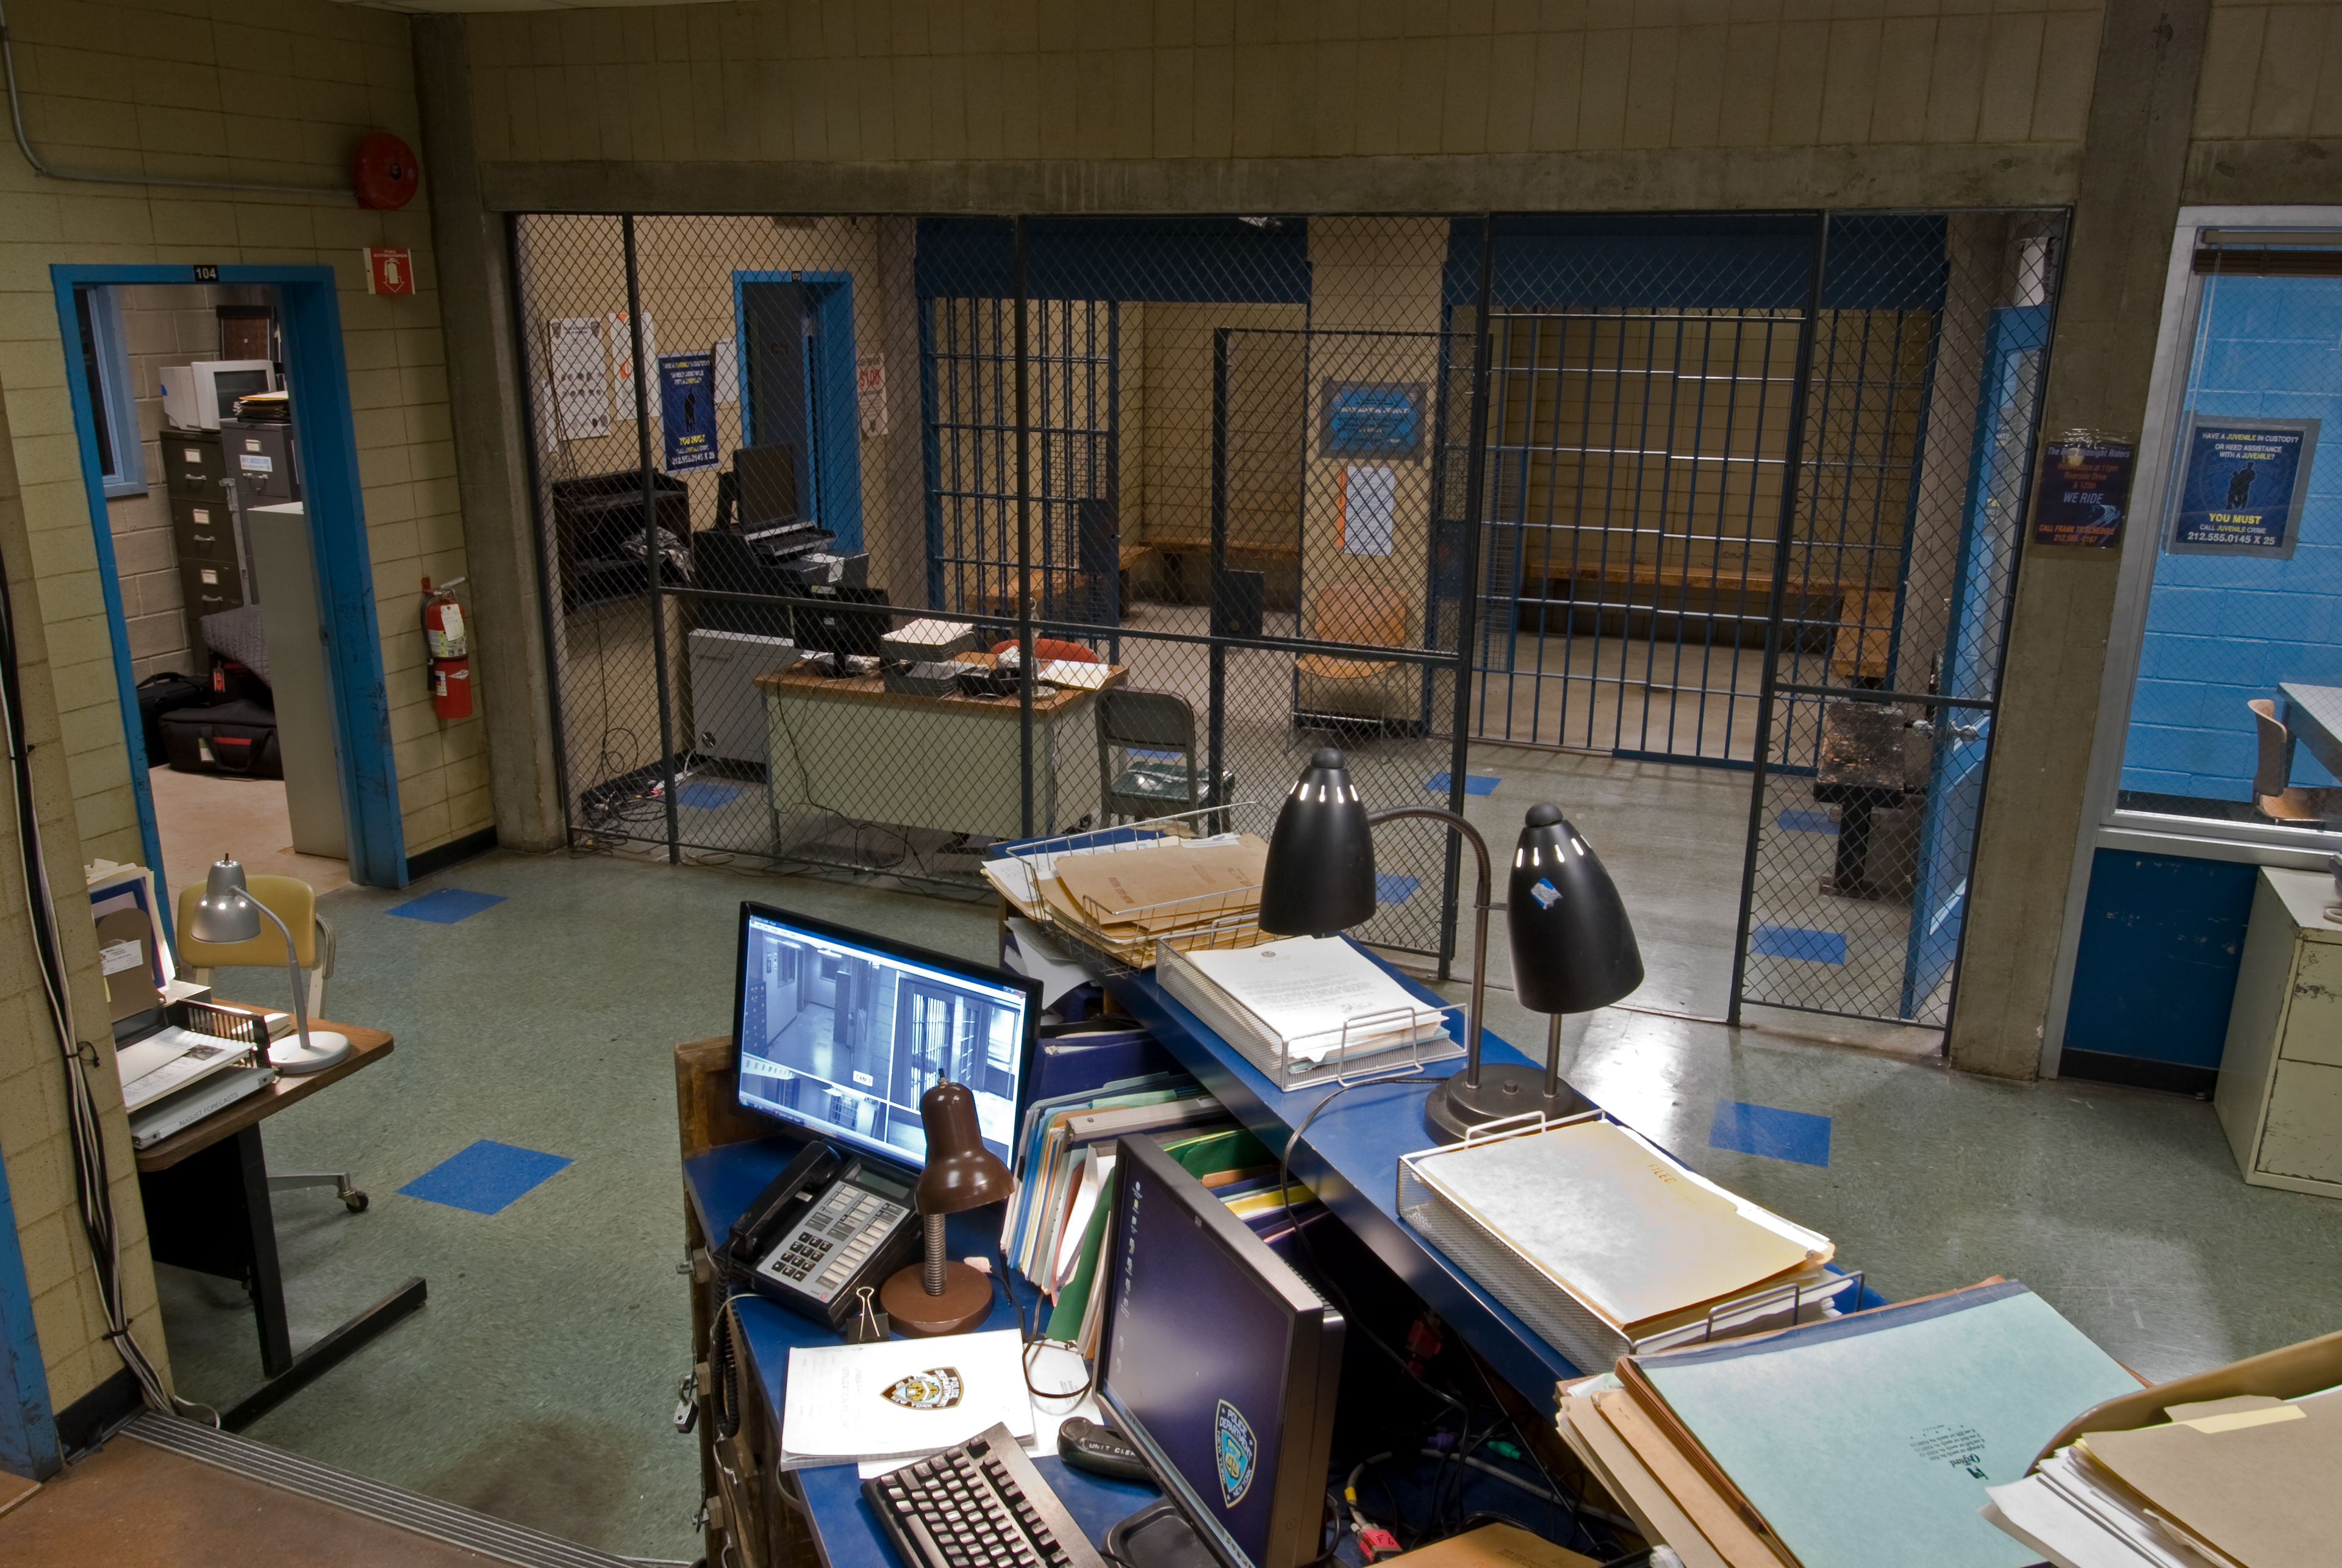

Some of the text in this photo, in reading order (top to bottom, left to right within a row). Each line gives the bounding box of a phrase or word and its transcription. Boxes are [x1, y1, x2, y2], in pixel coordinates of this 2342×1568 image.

[196, 267, 216, 279] 104
[2047, 446, 2060, 456] The
[2078, 448, 2107, 458] Midnight
[2108, 449, 2131, 458] Riders
[2102, 464, 2119, 473] 11pm
[2064, 471, 2090, 480] Riverside
[2063, 492, 2104, 504] WE RIDE
[2209, 514, 2261, 524] YOU MUST
[2187, 532, 2251, 543] 212.555.0145
[2253, 535, 2260, 544] X
[856, 1074, 867, 1083] CAM
[179, 1092, 238, 1126] AUGUST FORECASTS
[1646, 1164, 1677, 1183] FILED
[1227, 1409, 1247, 1439] POLICE
[1220, 1416, 1252, 1461] DEPARTMENT
[1233, 1466, 1252, 1497] NEW YORK
